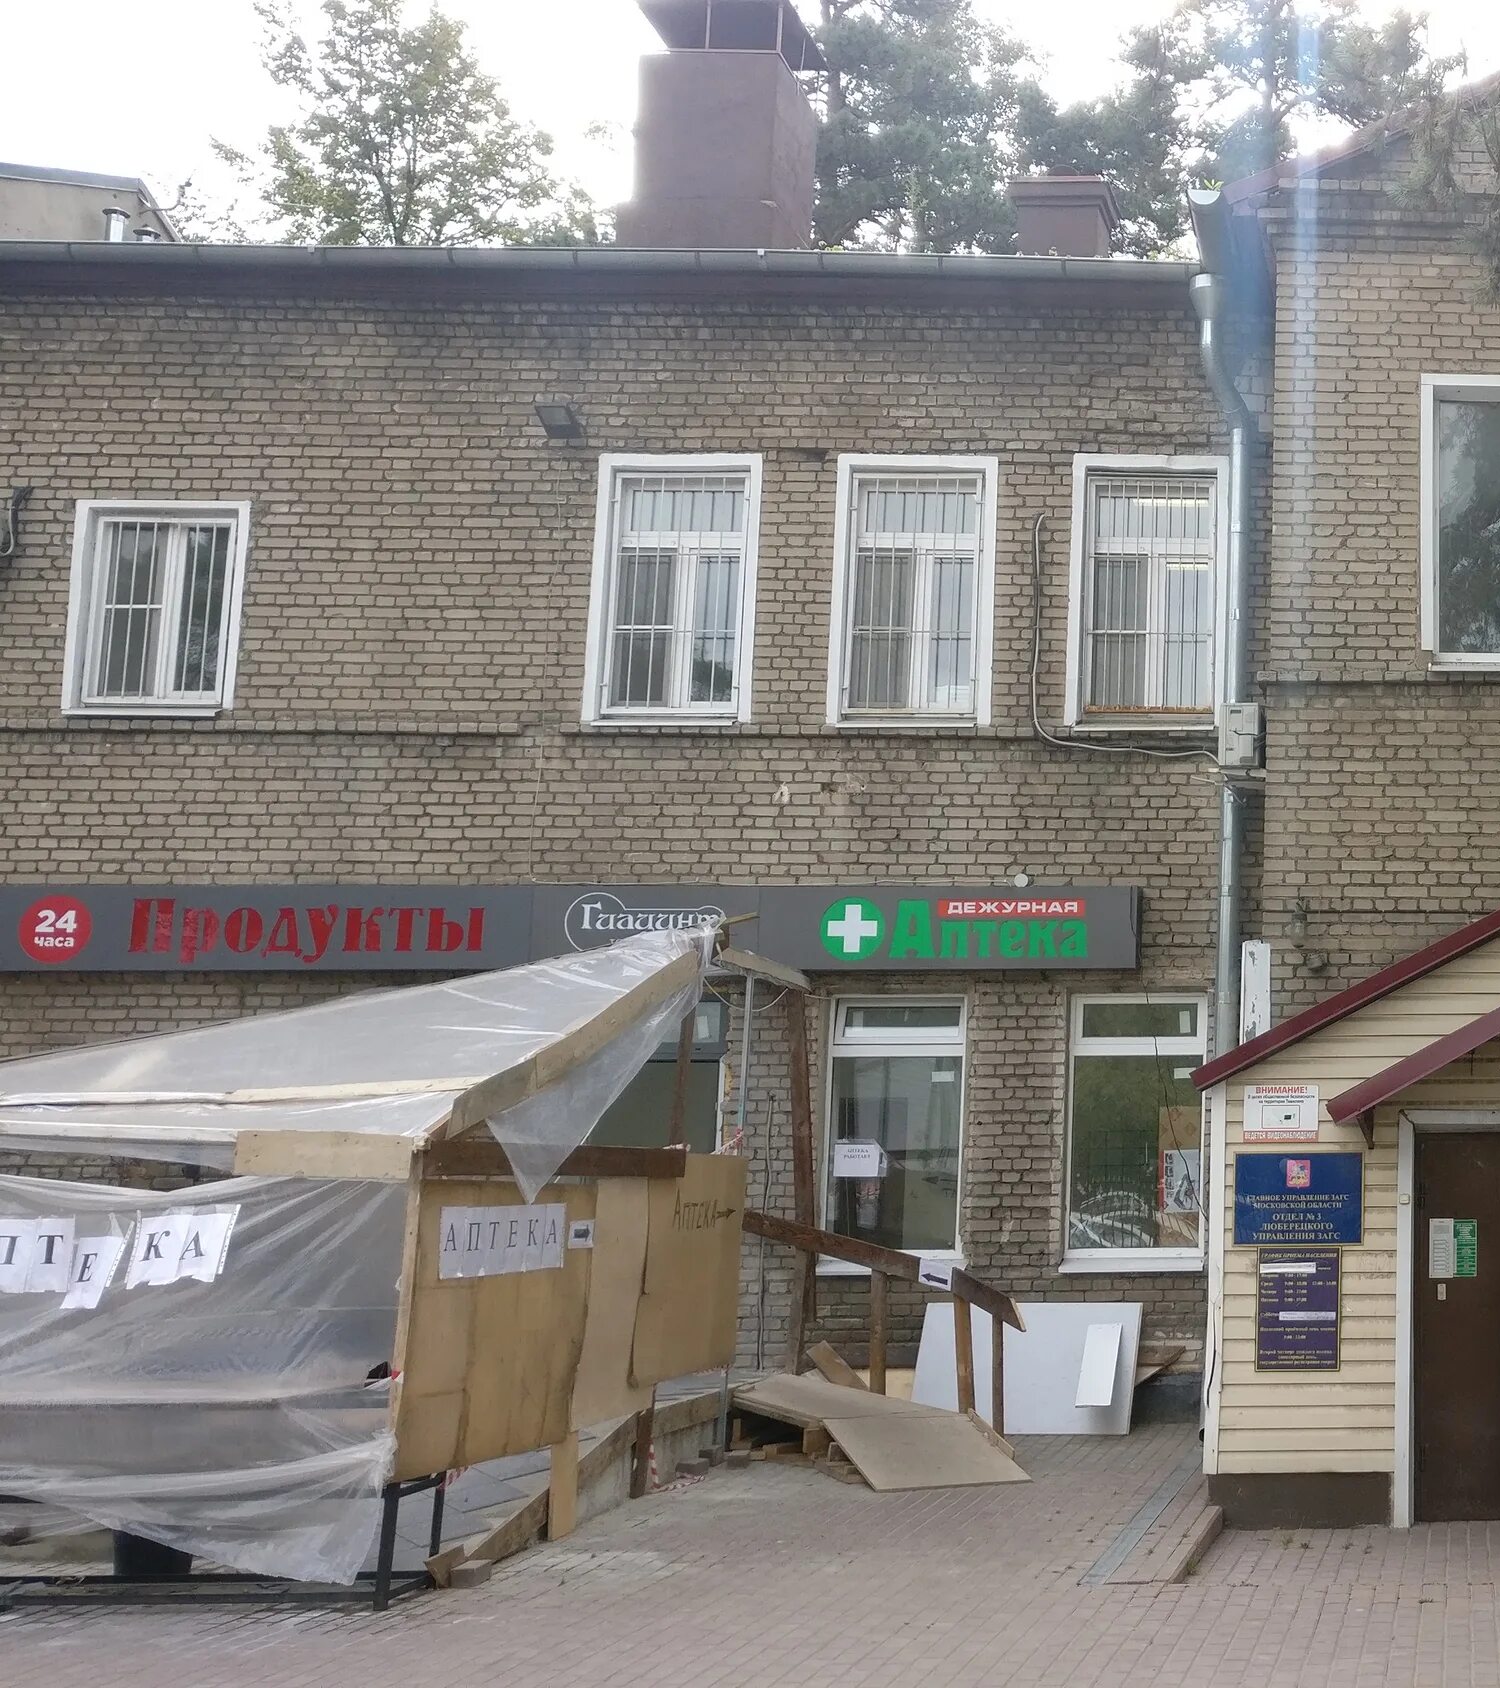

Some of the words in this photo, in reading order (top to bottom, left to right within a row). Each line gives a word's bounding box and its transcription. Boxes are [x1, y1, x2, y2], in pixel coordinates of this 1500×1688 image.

[947, 899, 1078, 915] ДЕЖУРНАЯ
[34, 909, 77, 934] 24
[127, 898, 484, 963] Продукты
[889, 899, 1088, 960] Аптека
[33, 935, 75, 949] часа
[1255, 1086, 1308, 1094] ВНИМАНИЕ!
[1253, 1201, 1306, 1209] МОСКОВСКОЙ
[1272, 1212, 1304, 1222] ОТДЕЛ
[1261, 1222, 1334, 1232] ЛЮБЕРЕЦКОГО
[444, 1218, 557, 1251] АПТЕКА
[1252, 1232, 1315, 1241] УПРАВЛЕНИЯ
[1317, 1232, 1341, 1240] ЗАГС
